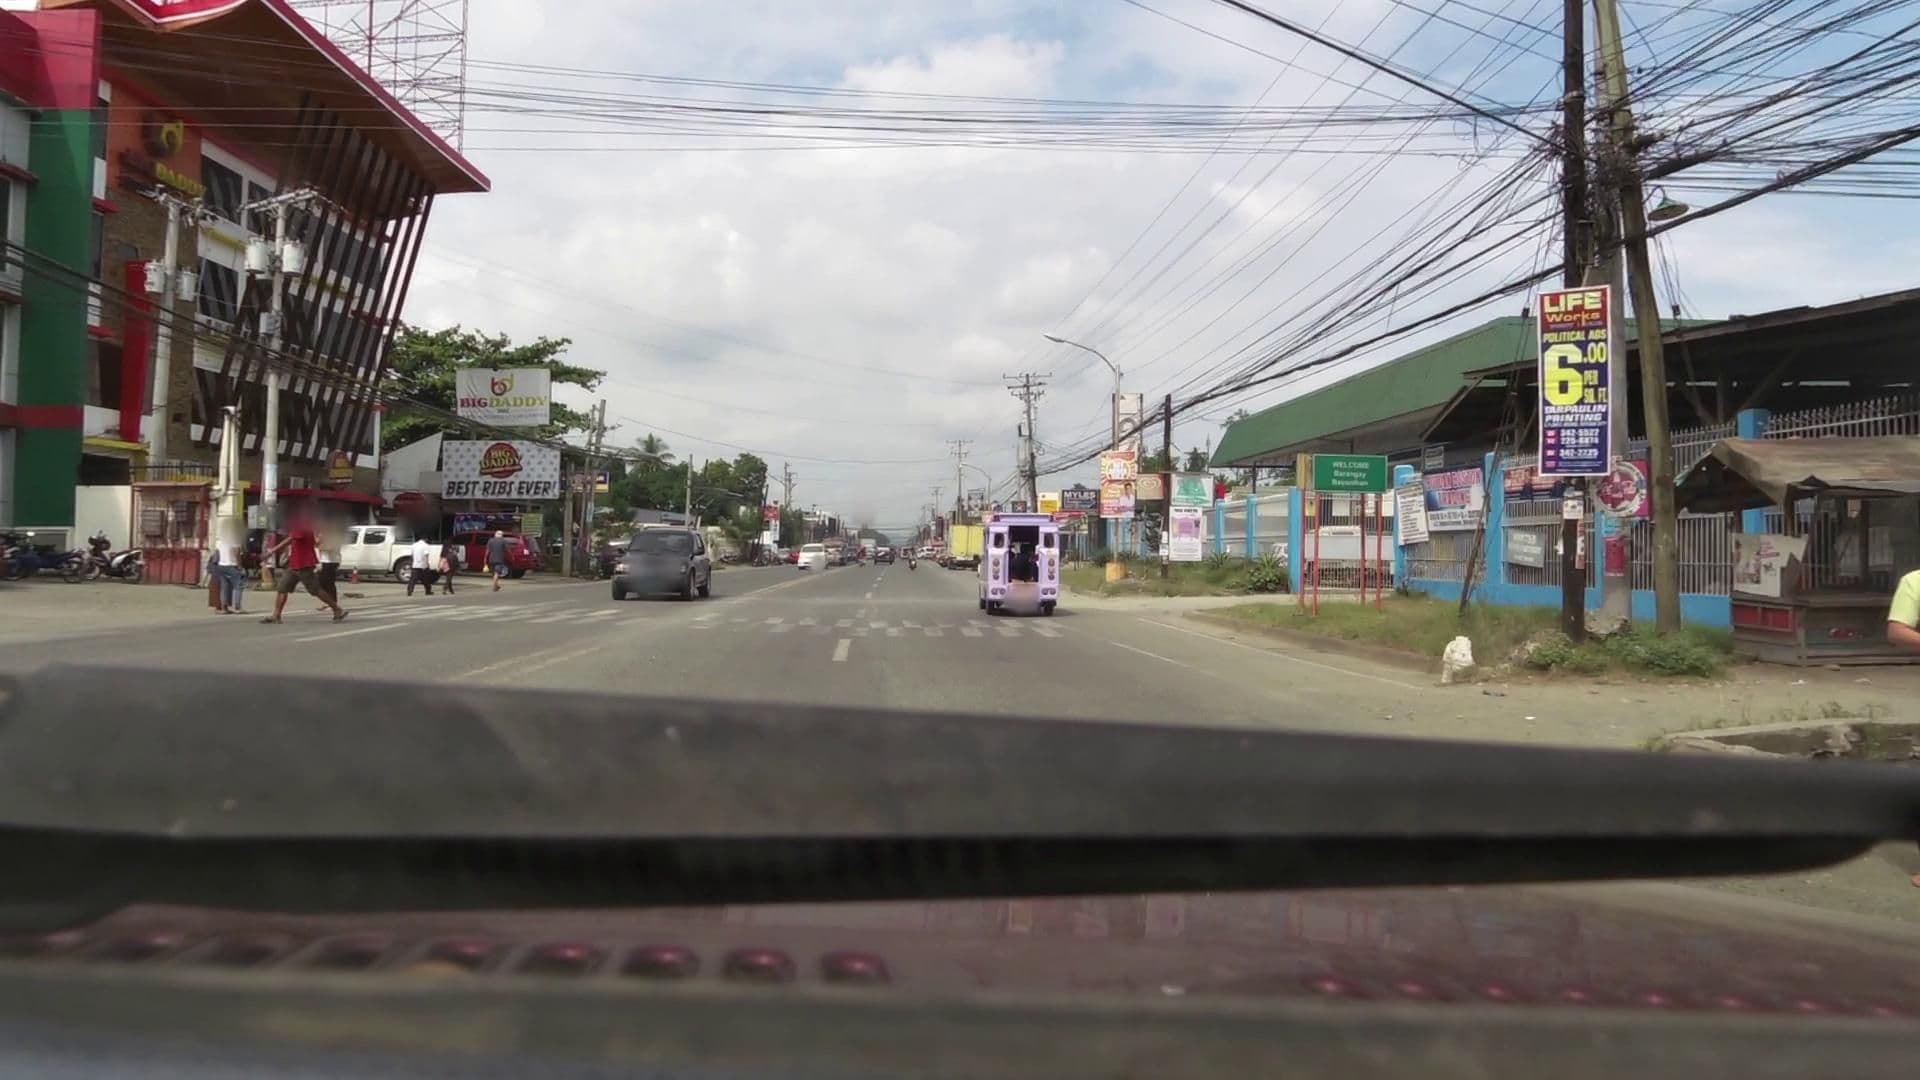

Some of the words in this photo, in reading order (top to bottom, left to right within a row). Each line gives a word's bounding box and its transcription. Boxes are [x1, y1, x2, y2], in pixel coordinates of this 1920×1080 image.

[1544, 291, 1602, 313] LIFE
[1546, 311, 1601, 325] Works
[1543, 330, 1586, 343] POLITICAL
[1588, 329, 1607, 340] ADS
[1583, 369, 1598, 385] PER
[1544, 404, 1607, 414] TARPAULIN
[1545, 413, 1602, 421] PRINTING
[490, 448, 512, 458] BIG
[481, 456, 521, 468] DADDY
[1333, 461, 1369, 469] WELCOME
[1333, 470, 1367, 479] Barangay
[447, 481, 480, 496] BEST
[482, 481, 516, 496] RIBS
[517, 480, 556, 496] EVER!
